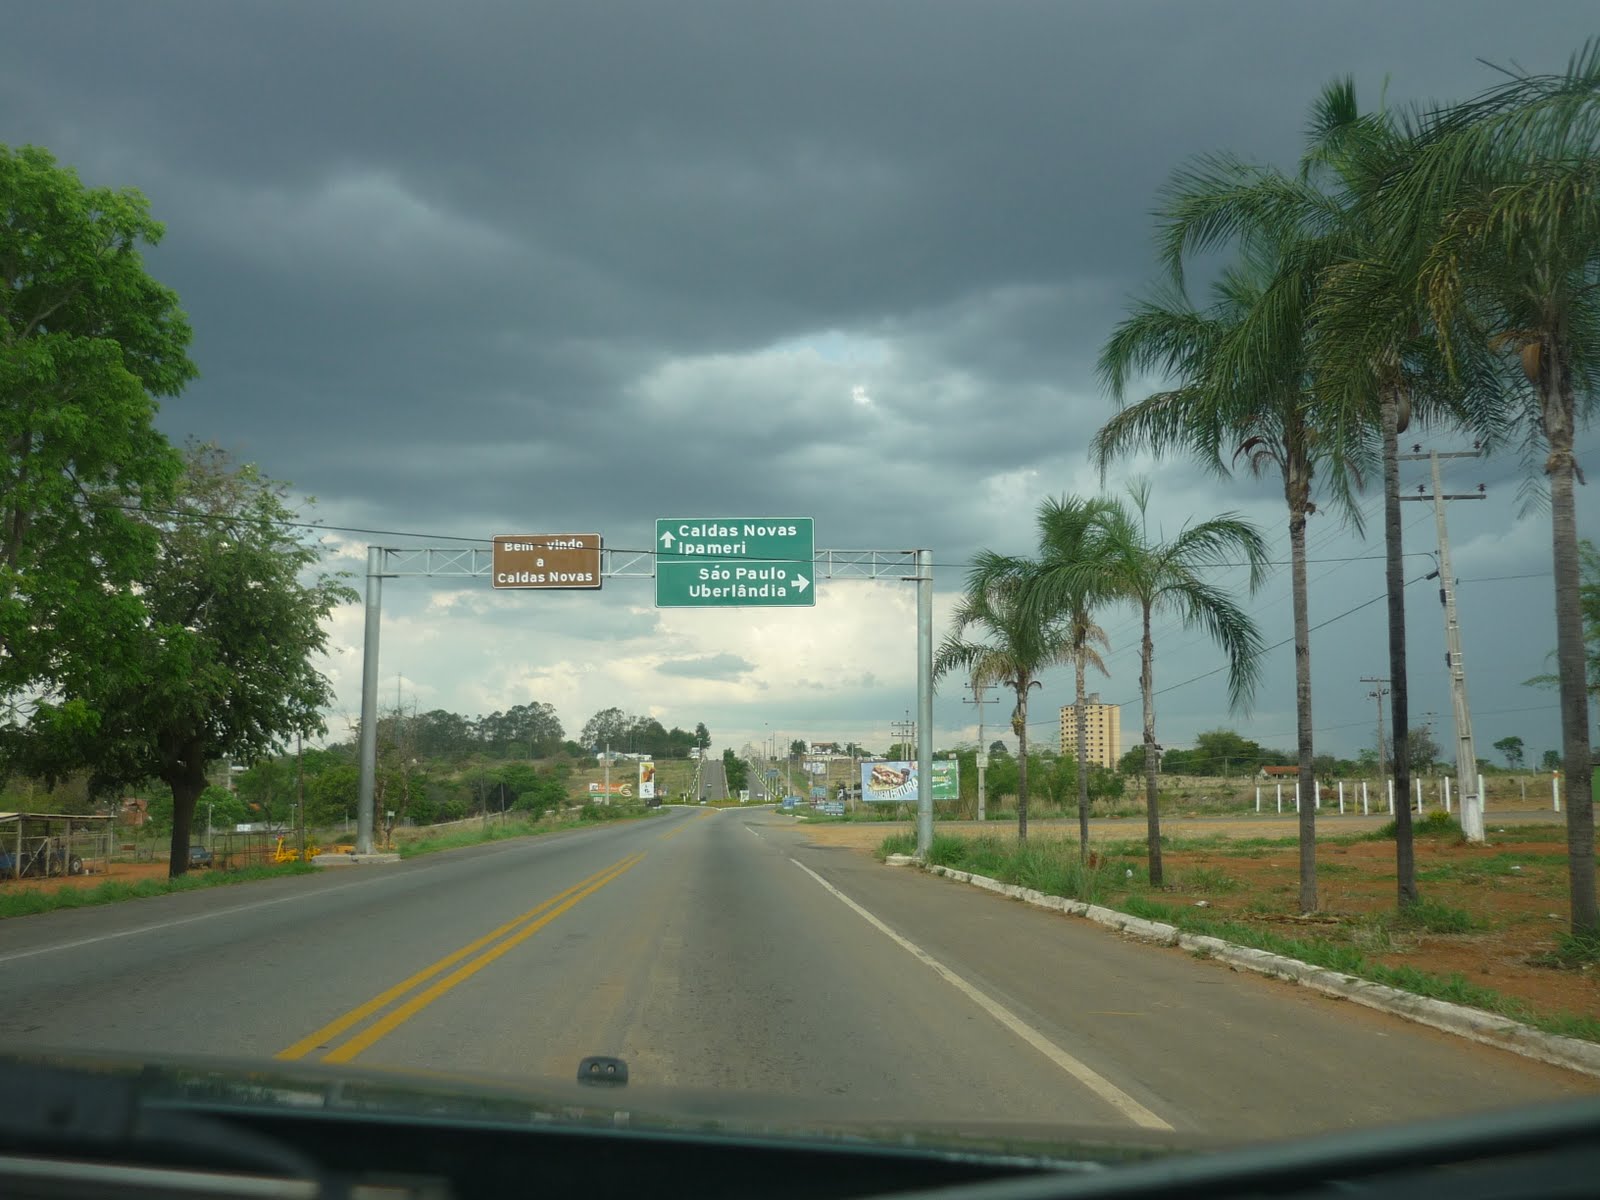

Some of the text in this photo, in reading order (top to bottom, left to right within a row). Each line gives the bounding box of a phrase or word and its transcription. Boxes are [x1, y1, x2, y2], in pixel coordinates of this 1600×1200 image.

[679, 524, 797, 537] Caldas Novas
[546, 538, 584, 550] vindo
[679, 541, 746, 556] Ipameri
[536, 558, 544, 567] a
[497, 571, 593, 583] Caldas Novas
[736, 567, 786, 580] Paulo
[689, 584, 786, 598] Uberlândia
